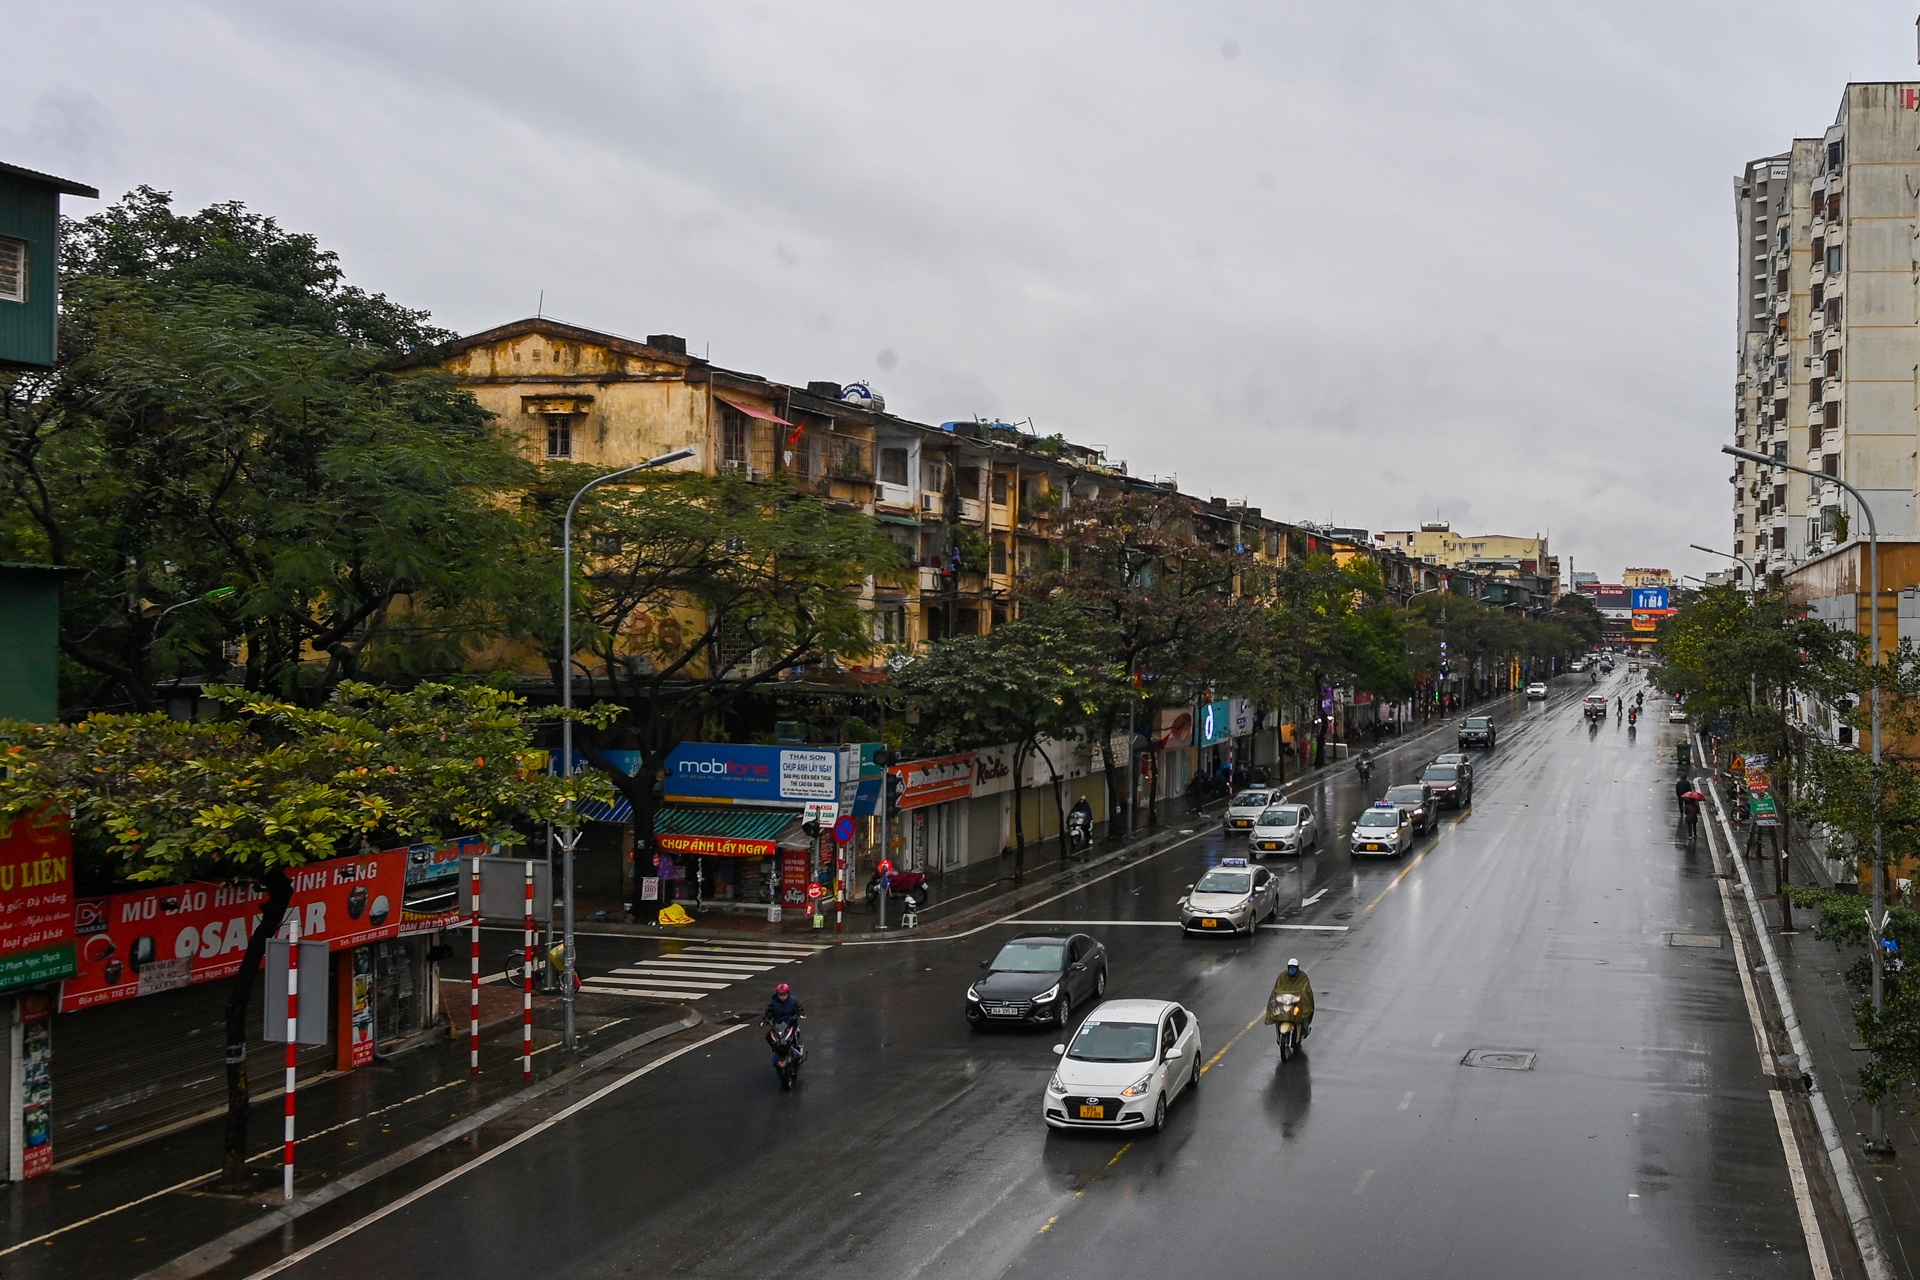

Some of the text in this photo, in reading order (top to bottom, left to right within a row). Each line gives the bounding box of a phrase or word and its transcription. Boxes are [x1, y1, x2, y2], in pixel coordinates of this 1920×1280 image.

[679, 757, 770, 777] mobifone
[818, 764, 833, 773] NGAY
[717, 840, 737, 854] LẤY
[738, 844, 769, 856] NGAY
[21, 851, 67, 888] LIÊN
[121, 896, 157, 923] MŨ
